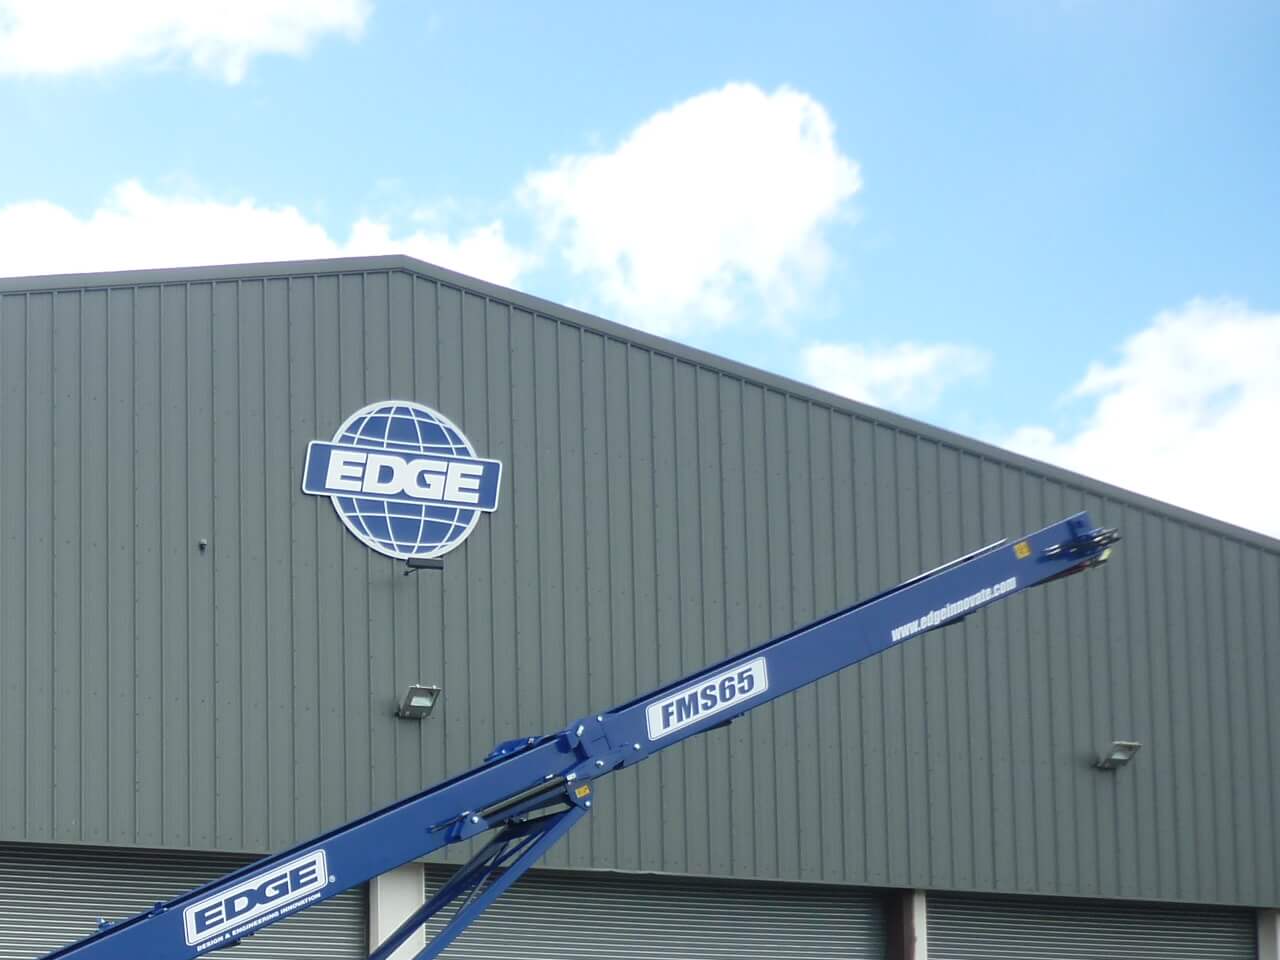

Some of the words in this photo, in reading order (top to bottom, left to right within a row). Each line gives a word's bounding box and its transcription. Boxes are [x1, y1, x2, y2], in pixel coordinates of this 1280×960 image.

[325, 449, 484, 504] EDGE
[890, 576, 1018, 642] www.edgeinnovate.com
[661, 667, 755, 730] FMS65
[194, 860, 318, 935] EDGE
